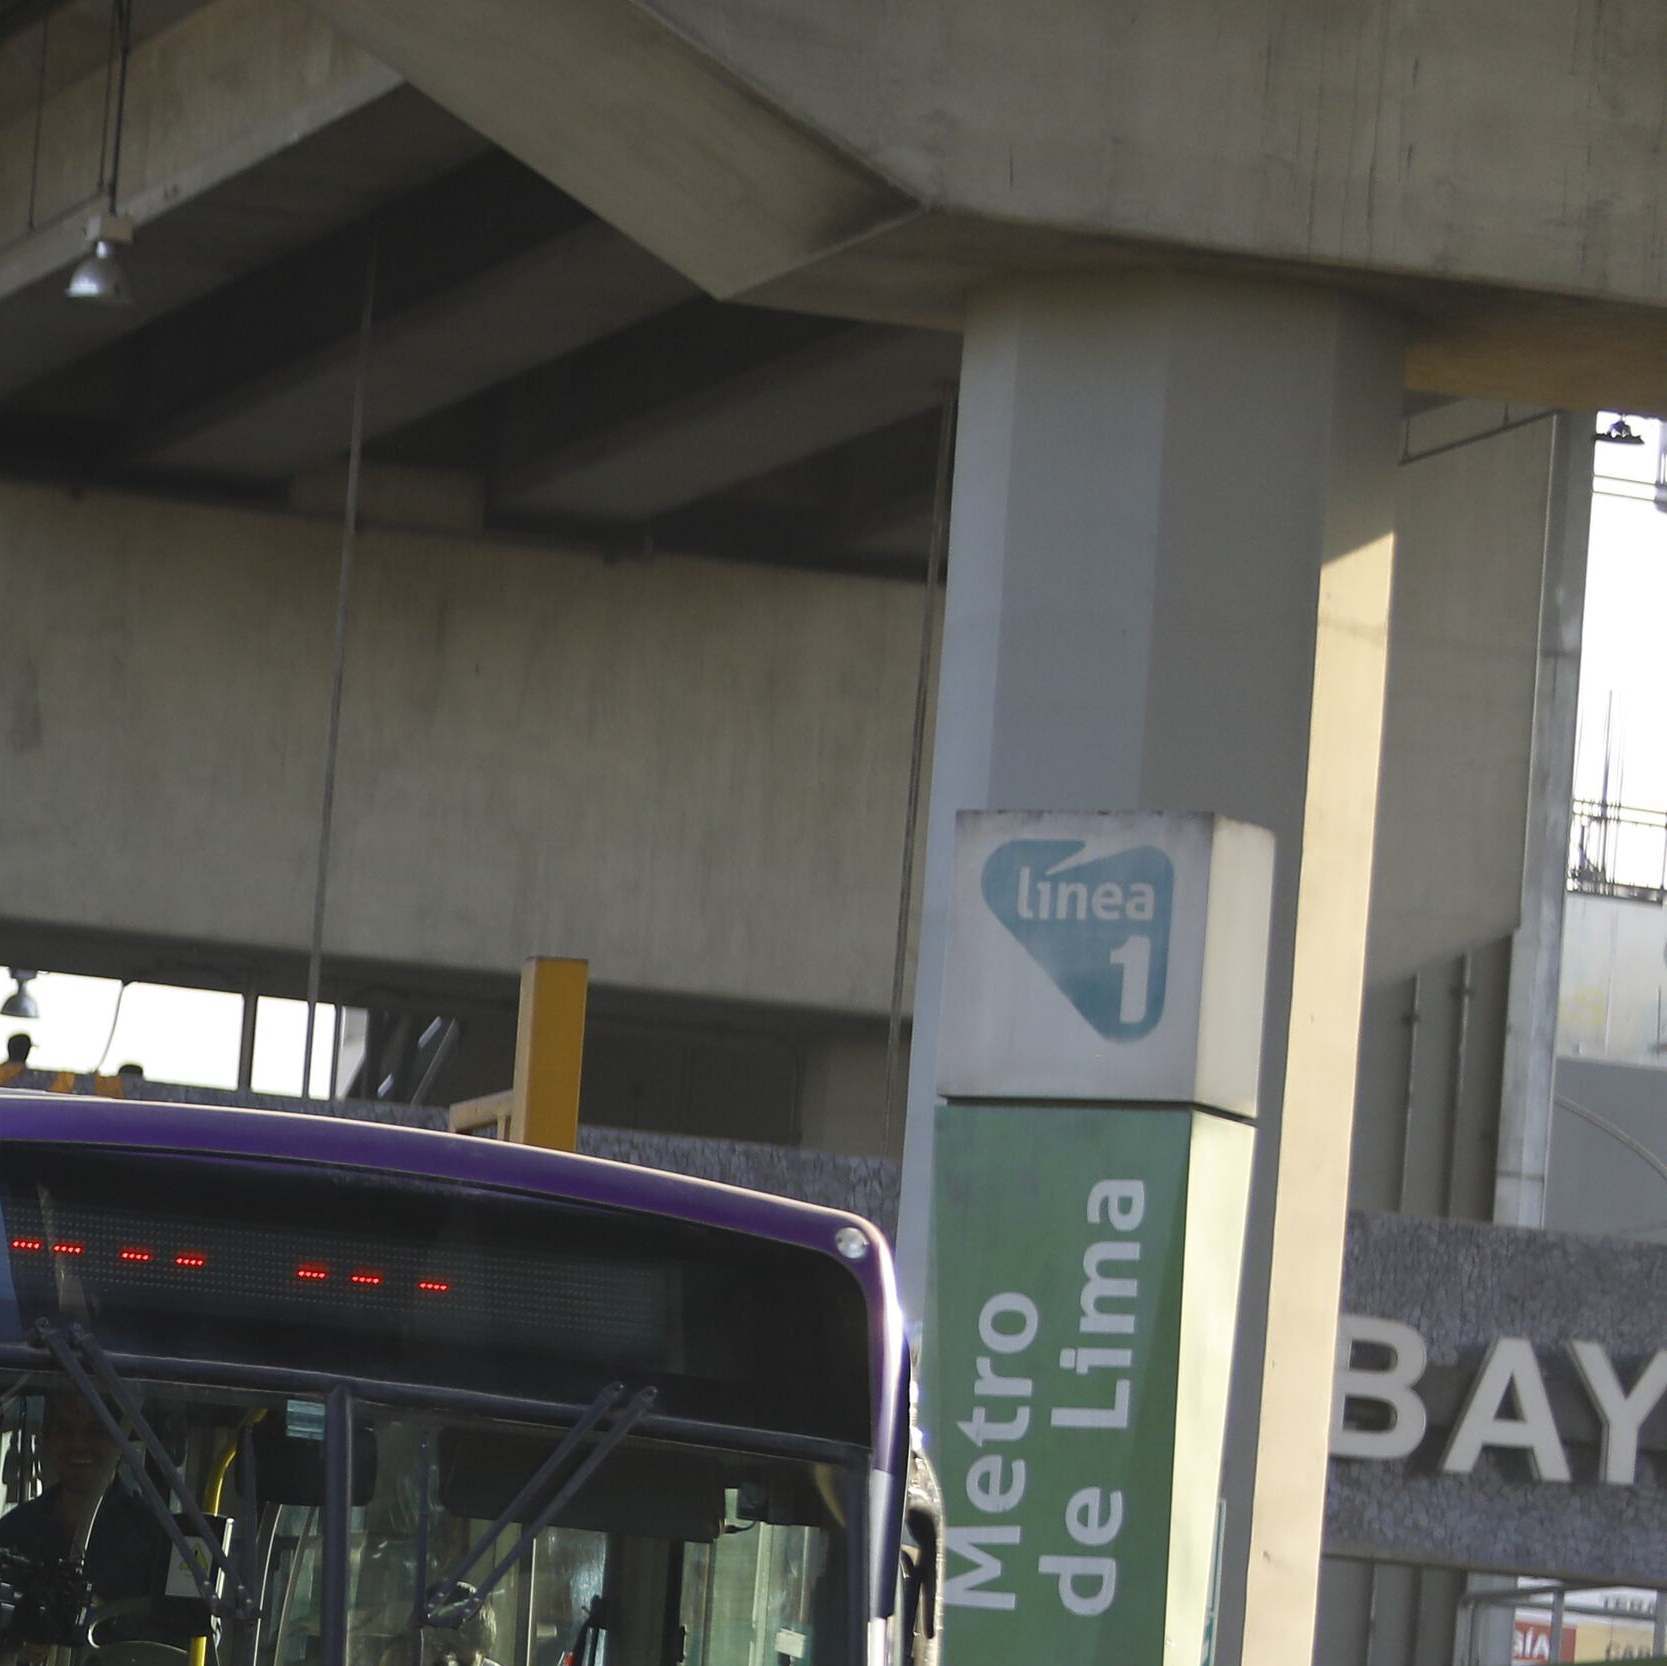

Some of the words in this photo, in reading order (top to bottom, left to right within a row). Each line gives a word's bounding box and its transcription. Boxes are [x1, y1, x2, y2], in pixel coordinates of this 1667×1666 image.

[1109, 935, 1151, 1025] 1
[1050, 1178, 1146, 1428] Lima
[944, 1292, 1038, 1610] Metro
[1038, 1486, 1124, 1617] de
